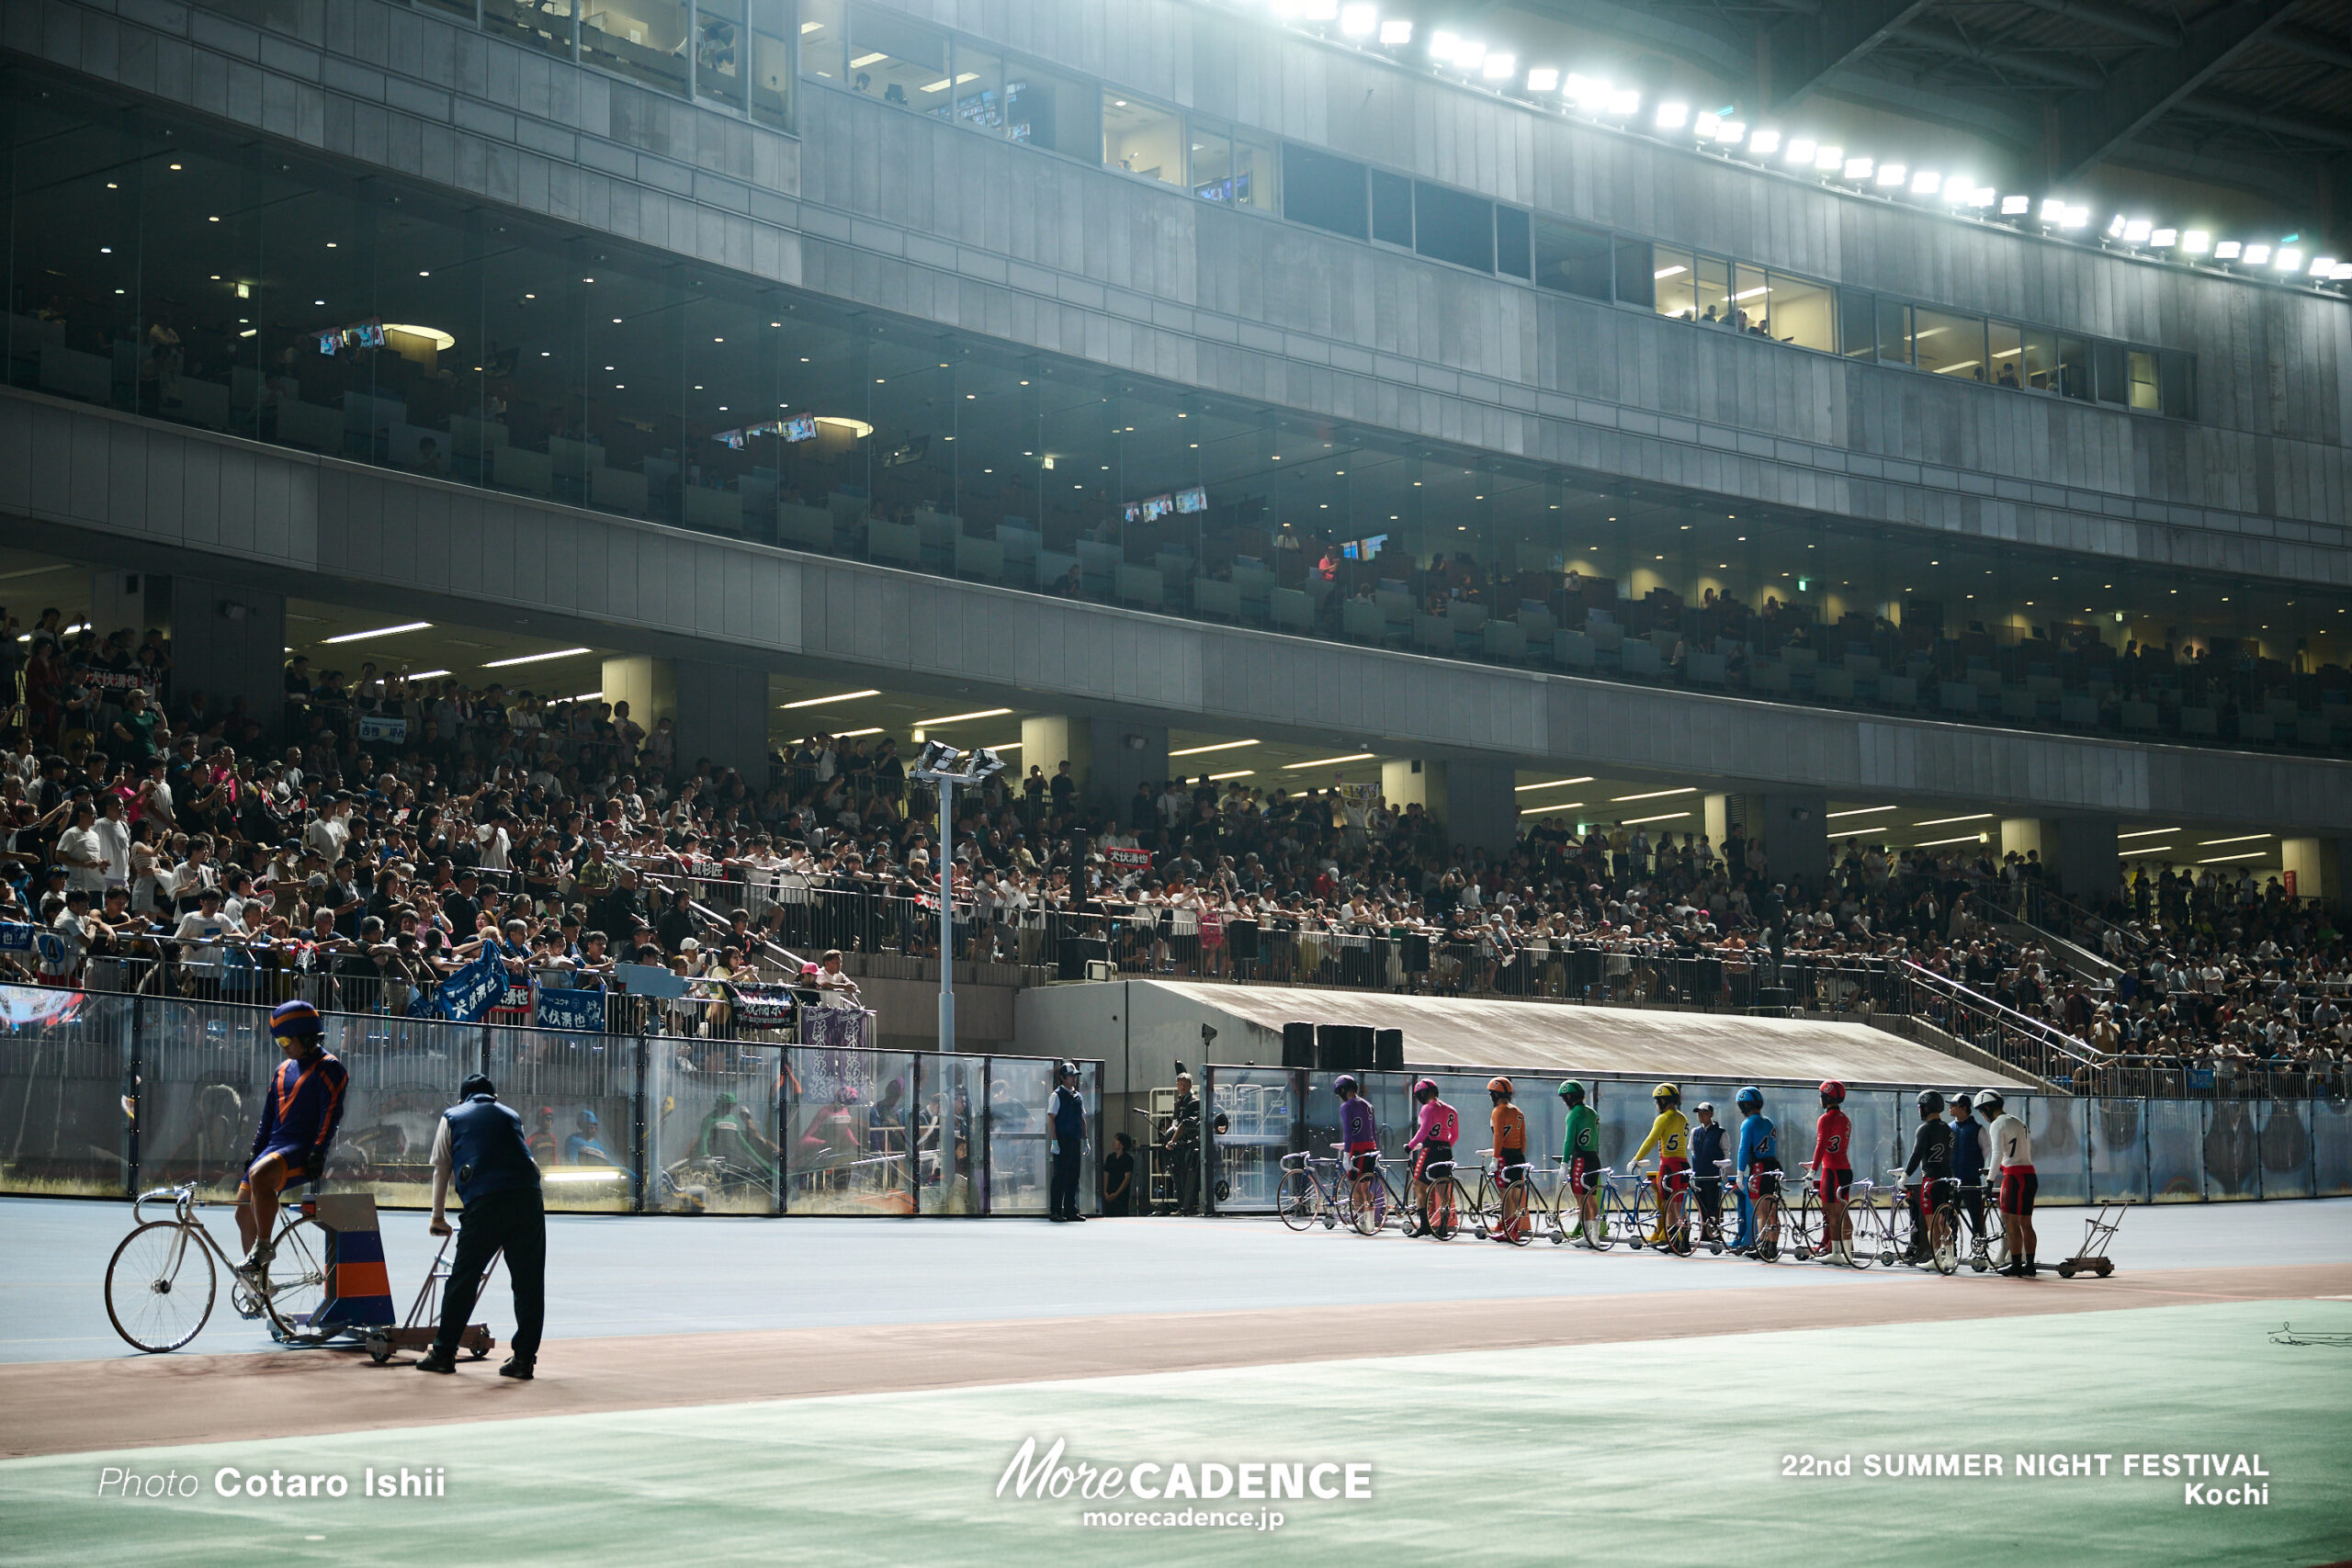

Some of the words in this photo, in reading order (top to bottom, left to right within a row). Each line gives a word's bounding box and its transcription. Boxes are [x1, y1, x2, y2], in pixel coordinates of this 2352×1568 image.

[1110, 851, 1148, 863] 犬伏湧也
[47, 938, 60, 960] 4
[537, 1005, 586, 1028] 犬伏湧也
[1657, 1087, 1664, 1096] 5
[1824, 1083, 1834, 1093] 3
[1920, 1093, 1930, 1103] 2
[1352, 1117, 1363, 1135] 9
[1447, 1113, 1454, 1127] 8
[1516, 1116, 1523, 1129] 7
[1429, 1123, 1442, 1137] 8
[1577, 1128, 1590, 1146] 6
[1683, 1122, 1690, 1137] 5
[1770, 1127, 1777, 1141] 4
[1667, 1134, 1679, 1152] 5
[1754, 1135, 1770, 1154] 4
[1826, 1135, 1841, 1153] 3
[1949, 1132, 1955, 1148] 2
[2008, 1137, 2017, 1157] 1
[1928, 1143, 1944, 1163] 2
